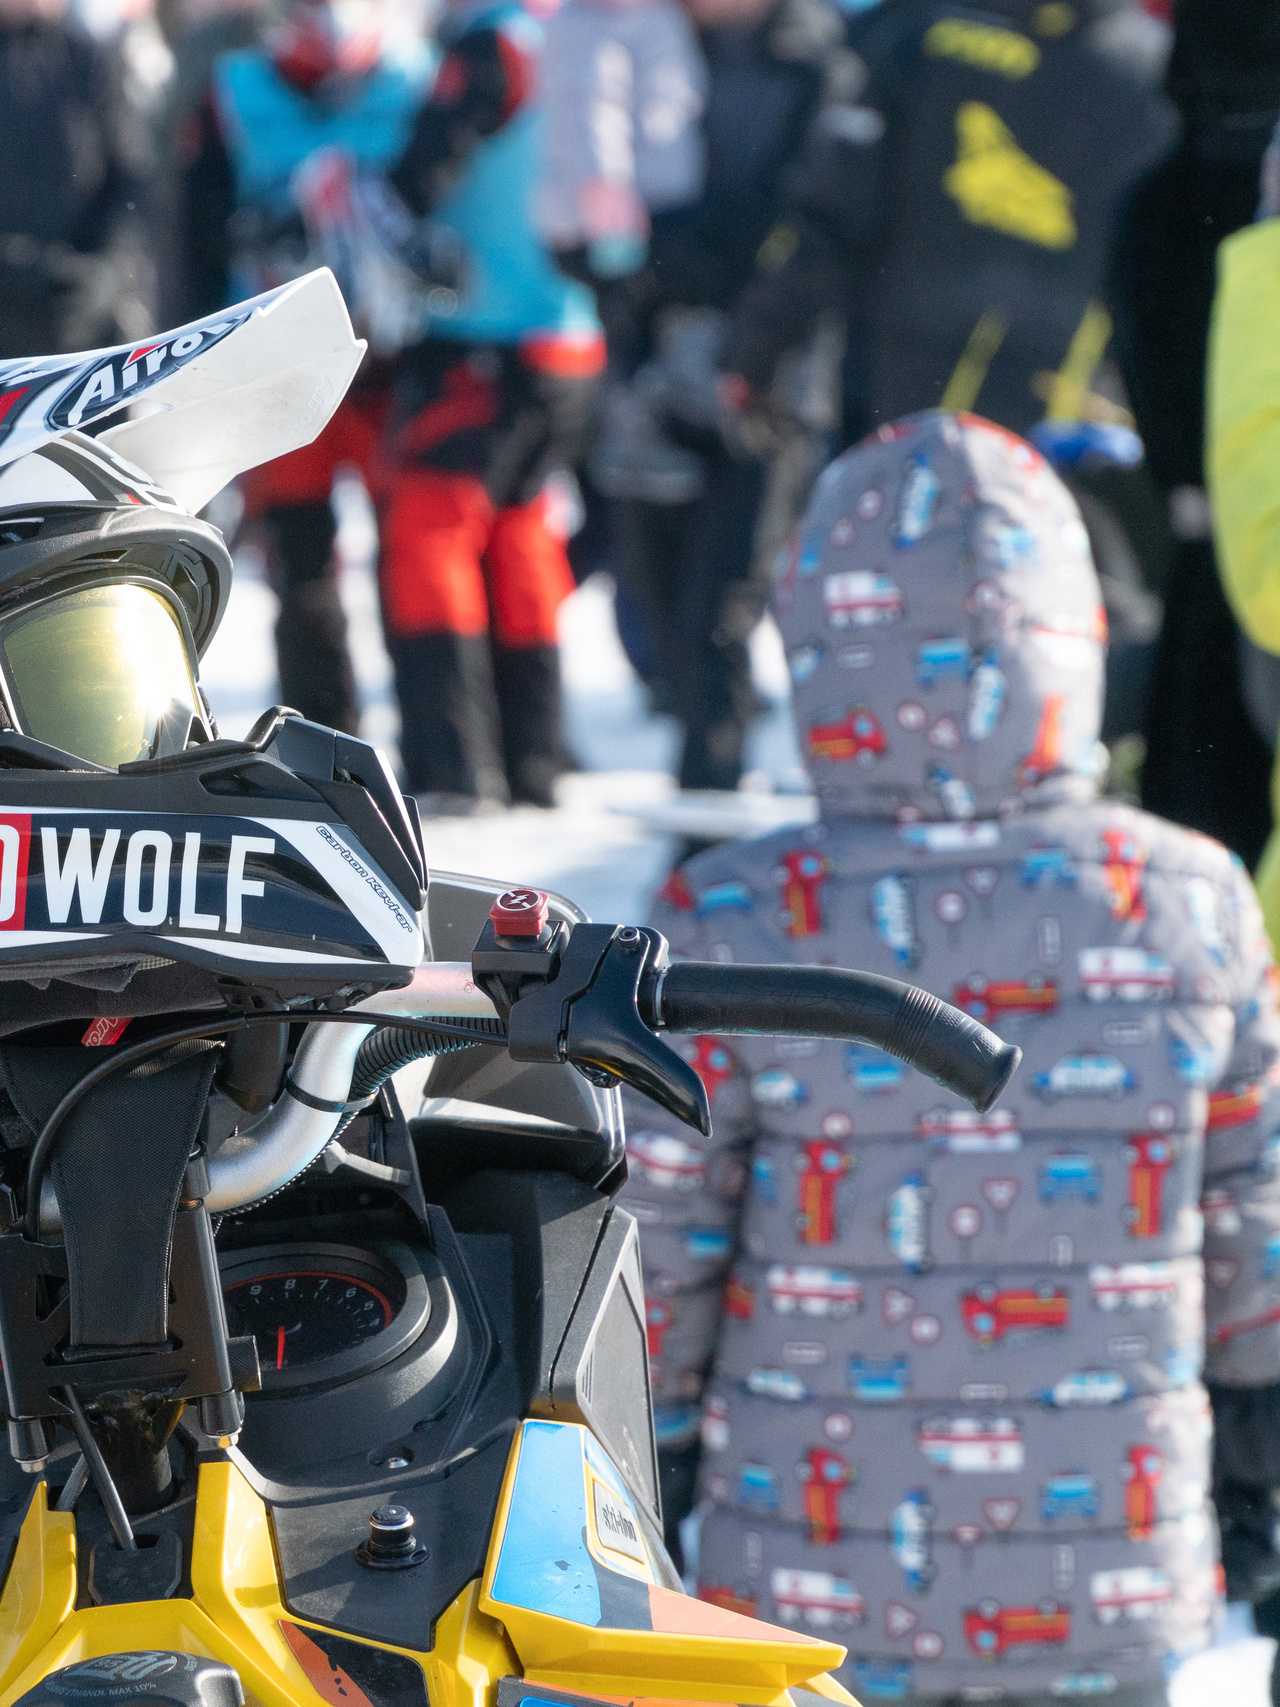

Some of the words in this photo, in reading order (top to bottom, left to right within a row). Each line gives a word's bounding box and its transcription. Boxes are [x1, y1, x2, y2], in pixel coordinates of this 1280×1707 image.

[315, 825, 369, 878] Carbon
[40, 826, 276, 934] WOLF
[249, 1284, 262, 1296] 9
[284, 1278, 297, 1290] 8
[318, 1278, 329, 1291] 7
[345, 1287, 357, 1298] 6
[109, 1686, 133, 1697] MAX
